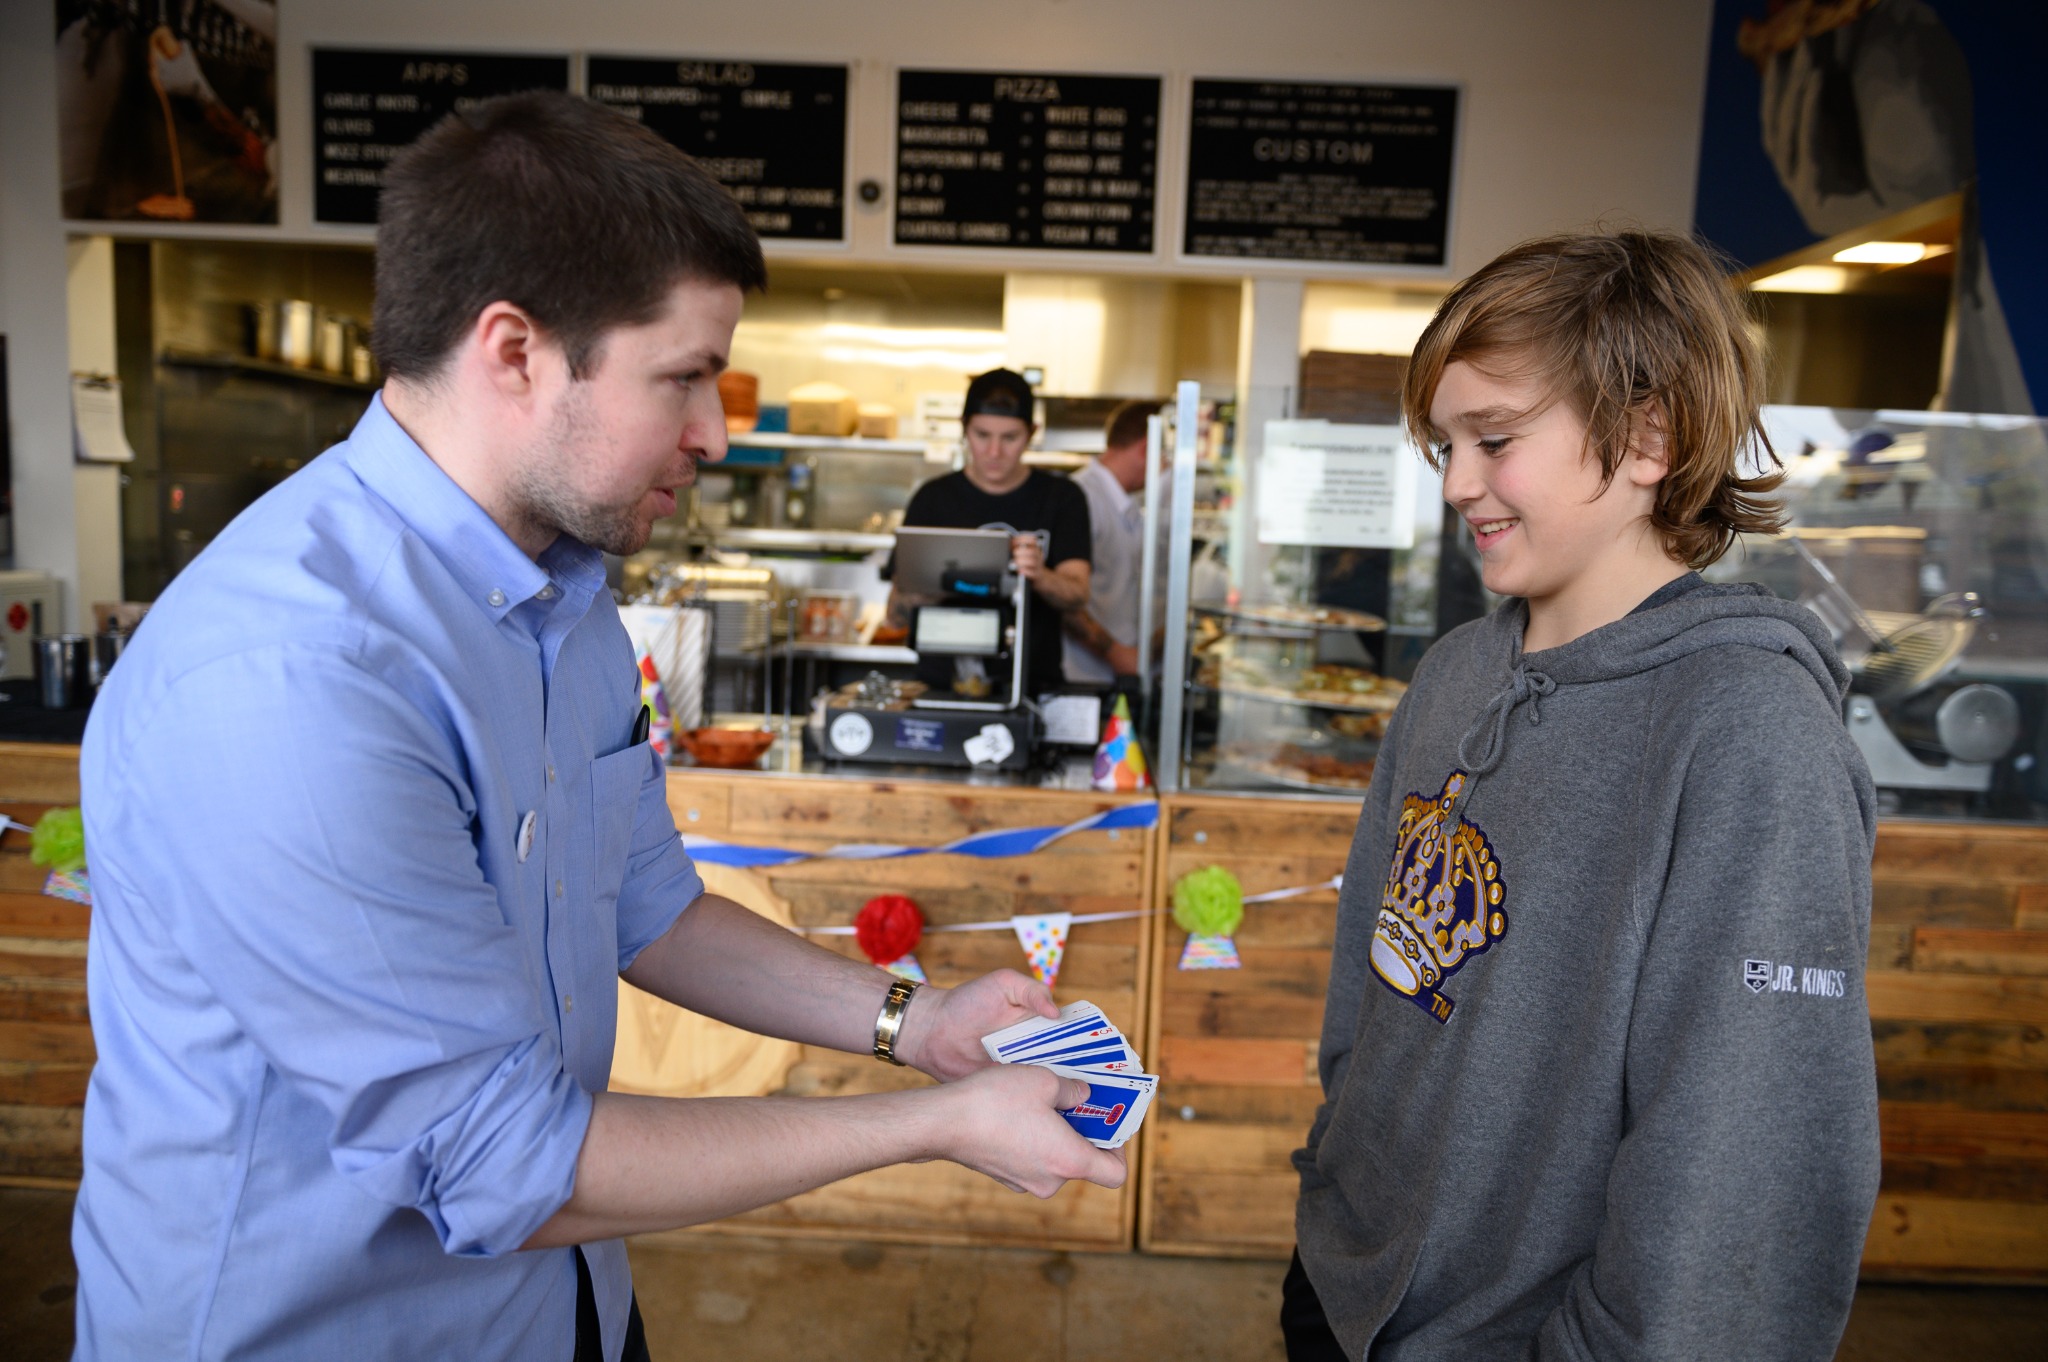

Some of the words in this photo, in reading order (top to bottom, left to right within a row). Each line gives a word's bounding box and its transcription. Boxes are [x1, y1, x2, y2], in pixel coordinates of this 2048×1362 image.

[401, 61, 470, 86] APPS
[677, 61, 755, 85] SALAD
[994, 79, 1062, 102] PIZZA
[901, 102, 960, 121] CHEESE
[968, 103, 994, 123] PIE
[1044, 106, 1090, 125] WHITE
[979, 151, 1004, 171] PIE
[1253, 137, 1374, 165] CUSTOM
[1772, 965, 1798, 992] JR.
[1802, 967, 1846, 997] KINGS
[1431, 993, 1451, 1020] TM
